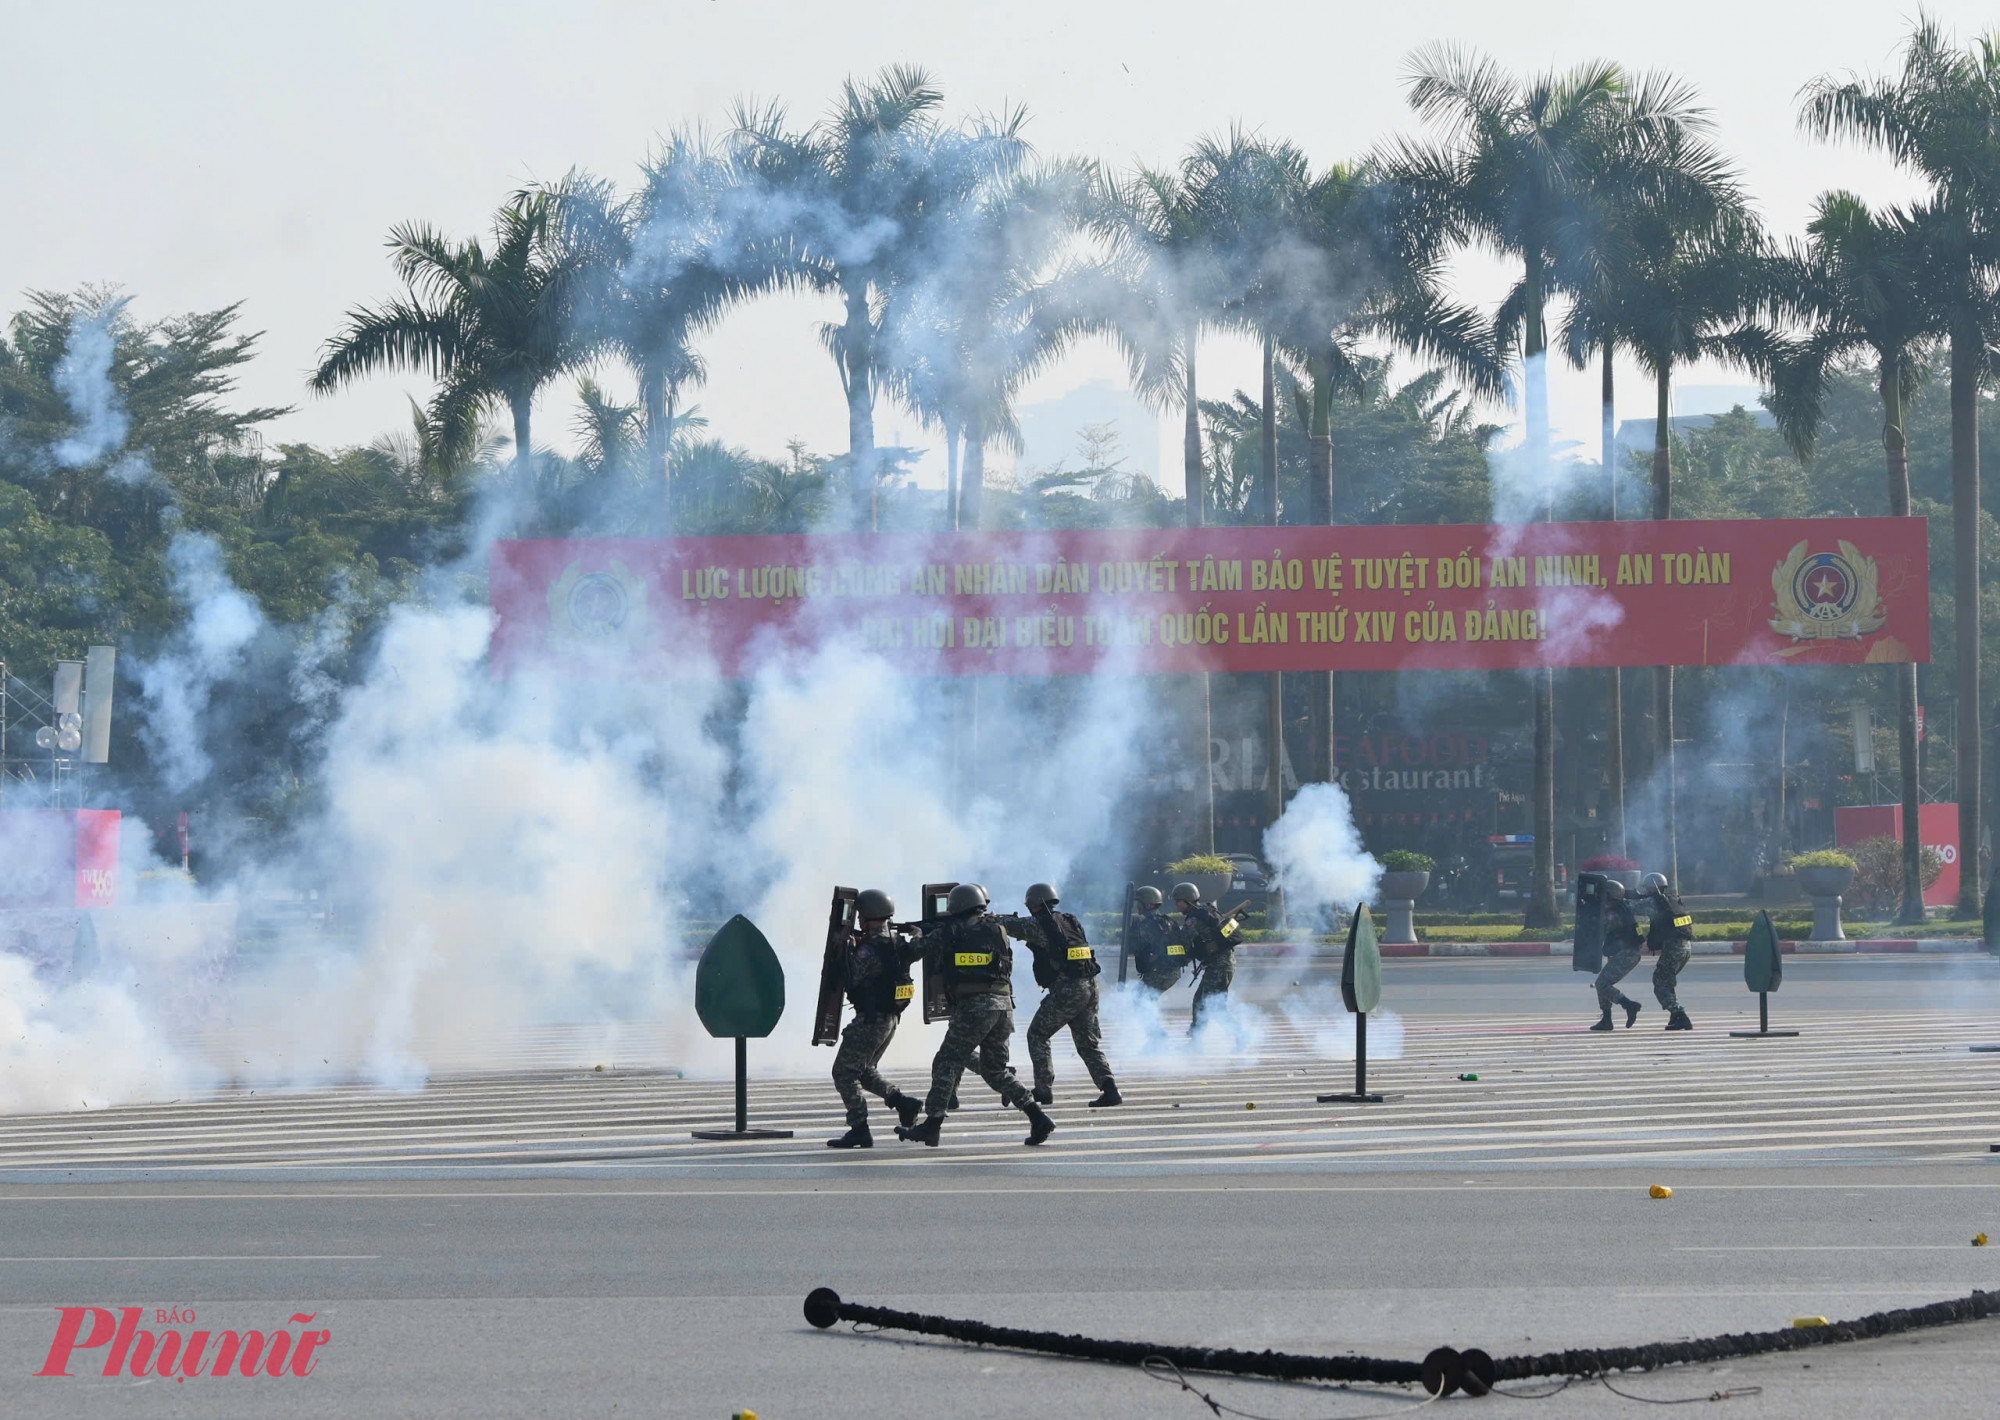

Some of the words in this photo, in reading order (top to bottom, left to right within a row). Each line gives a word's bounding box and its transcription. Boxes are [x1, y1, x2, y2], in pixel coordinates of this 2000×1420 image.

[681, 566, 731, 607] LỰC
[737, 564, 824, 604] LƯỢNG
[911, 563, 948, 596] AN
[955, 555, 1028, 597] NHÂN
[1035, 555, 1092, 595] DÂN
[1098, 548, 1180, 597] QUYẾT
[1186, 553, 1243, 592] TÂM
[1251, 548, 1304, 590] BẢO
[1311, 552, 1344, 597] VỆ
[1351, 551, 1429, 597] TUYỆT
[1436, 546, 1482, 589] ĐỐI
[1489, 558, 1527, 588] AN
[1534, 555, 1609, 592] NINH,
[1615, 554, 1655, 586] AN
[1660, 546, 1732, 584] TOÀN
[962, 614, 1006, 654] ĐẠI
[1014, 603, 1076, 648] BIỂU
[1159, 602, 1230, 648] QUỐC
[1236, 602, 1290, 644] LẦN
[1295, 604, 1348, 643] THỨ
[1353, 610, 1396, 643] XIV
[1403, 600, 1458, 643] CỦA
[1464, 598, 1548, 641] ĐẢNG!
